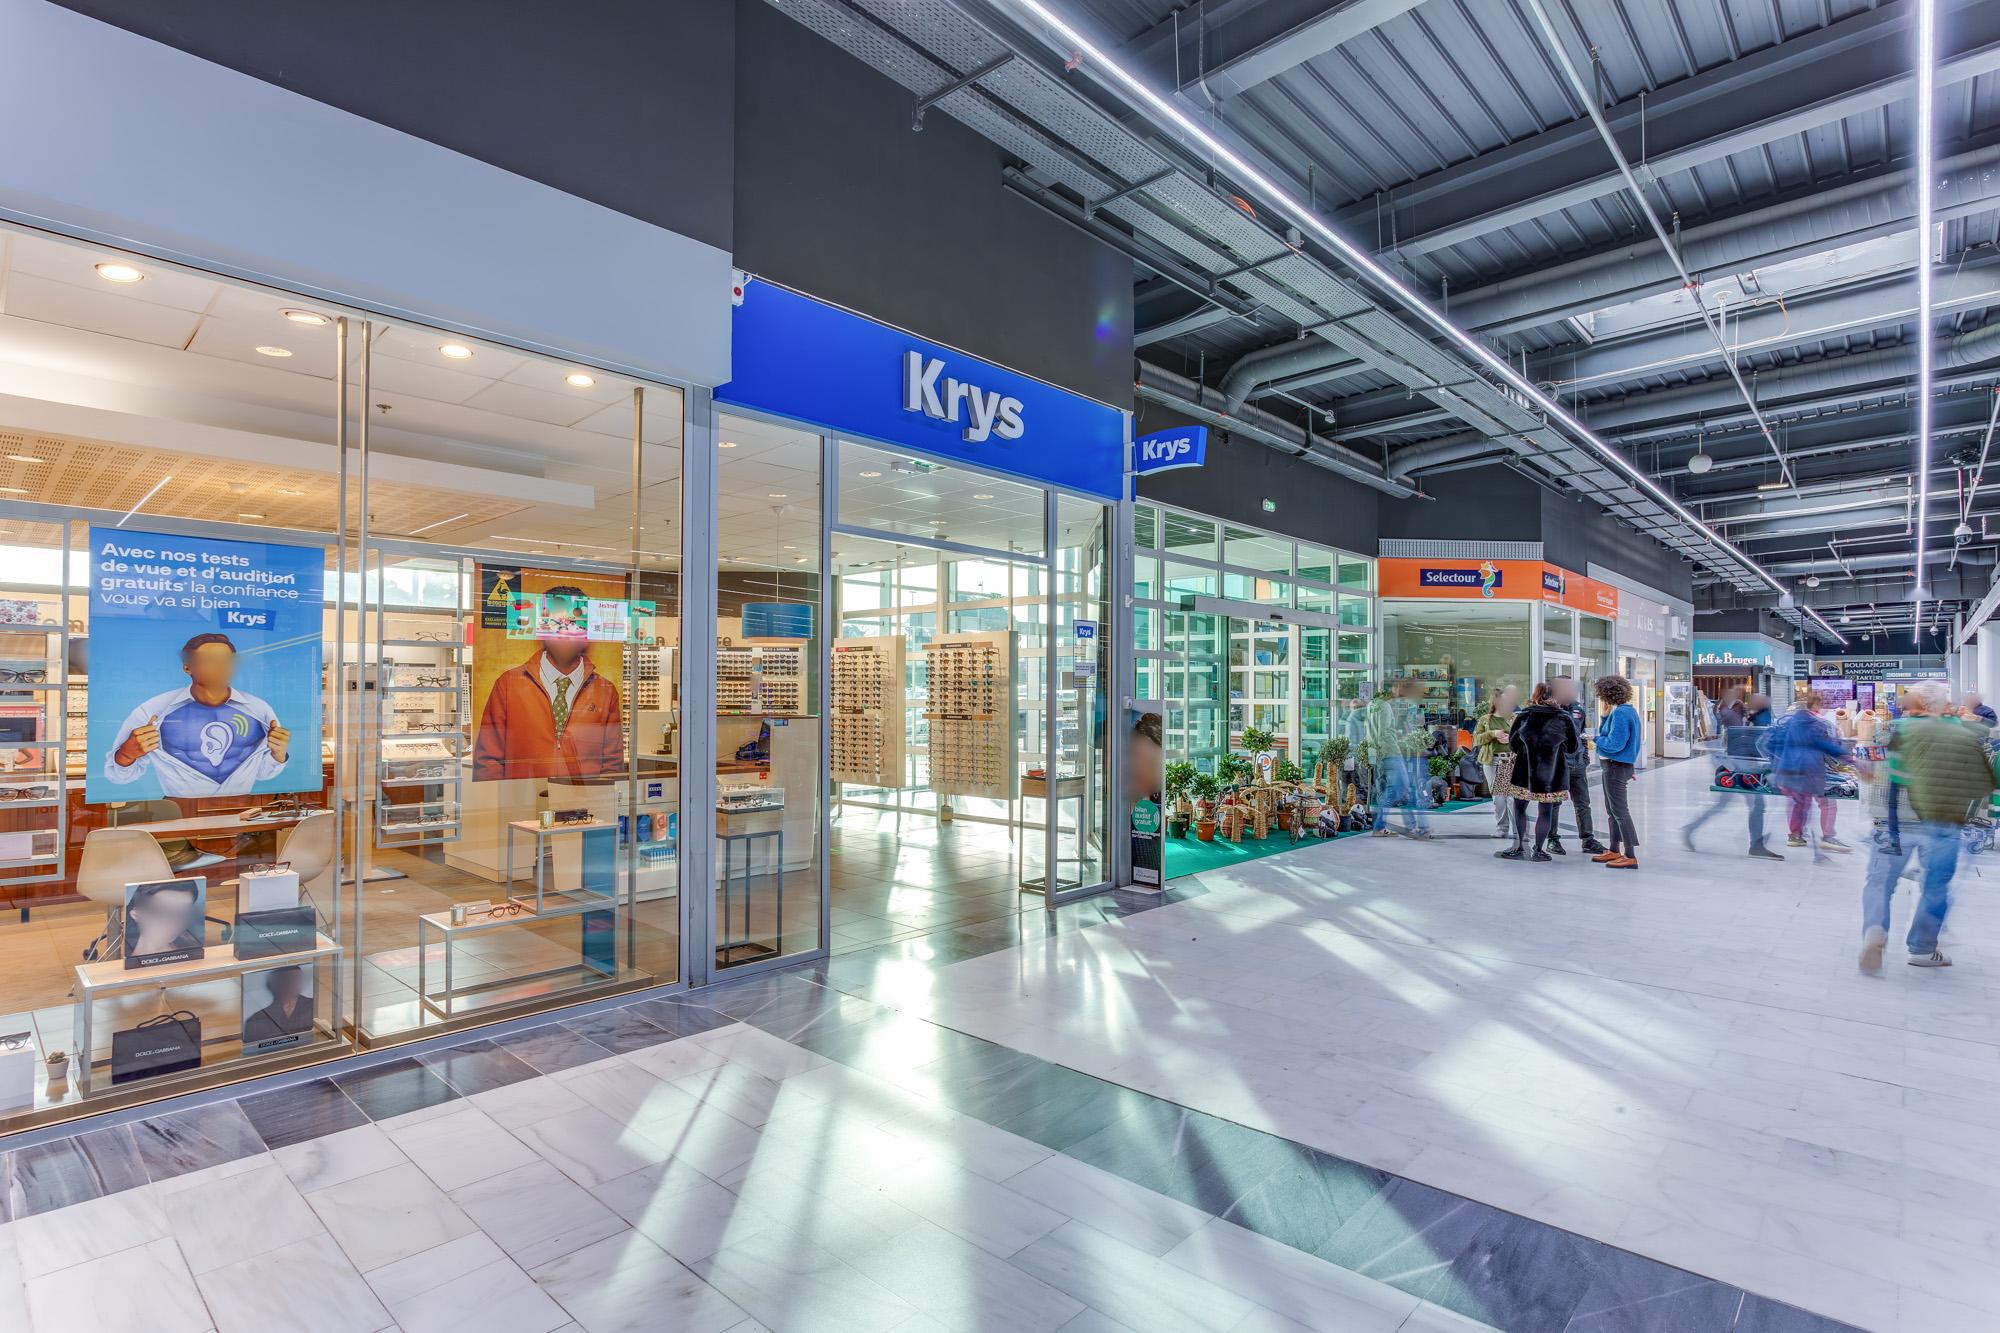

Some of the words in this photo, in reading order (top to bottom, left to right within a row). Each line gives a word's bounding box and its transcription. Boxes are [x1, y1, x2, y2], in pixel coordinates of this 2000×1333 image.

[903, 350, 1024, 442] Krys
[1142, 436, 1191, 461] Krys
[101, 543, 156, 559] Avec
[160, 550, 197, 562] nos
[201, 552, 250, 567] tests
[100, 559, 128, 573] de
[133, 564, 172, 576] vue
[176, 565, 197, 578] et
[201, 567, 295, 585] d'audition
[1426, 571, 1477, 583] Selectour
[191, 580, 207, 593] la
[210, 584, 298, 599] confiance
[100, 593, 150, 605] vous
[153, 596, 177, 607] va
[181, 595, 196, 608] si
[201, 596, 240, 609] bien
[227, 611, 267, 627] Krys
[1696, 653, 1715, 665] Jeff
[1715, 654, 1723, 664] de
[1723, 652, 1758, 665] Bruges
